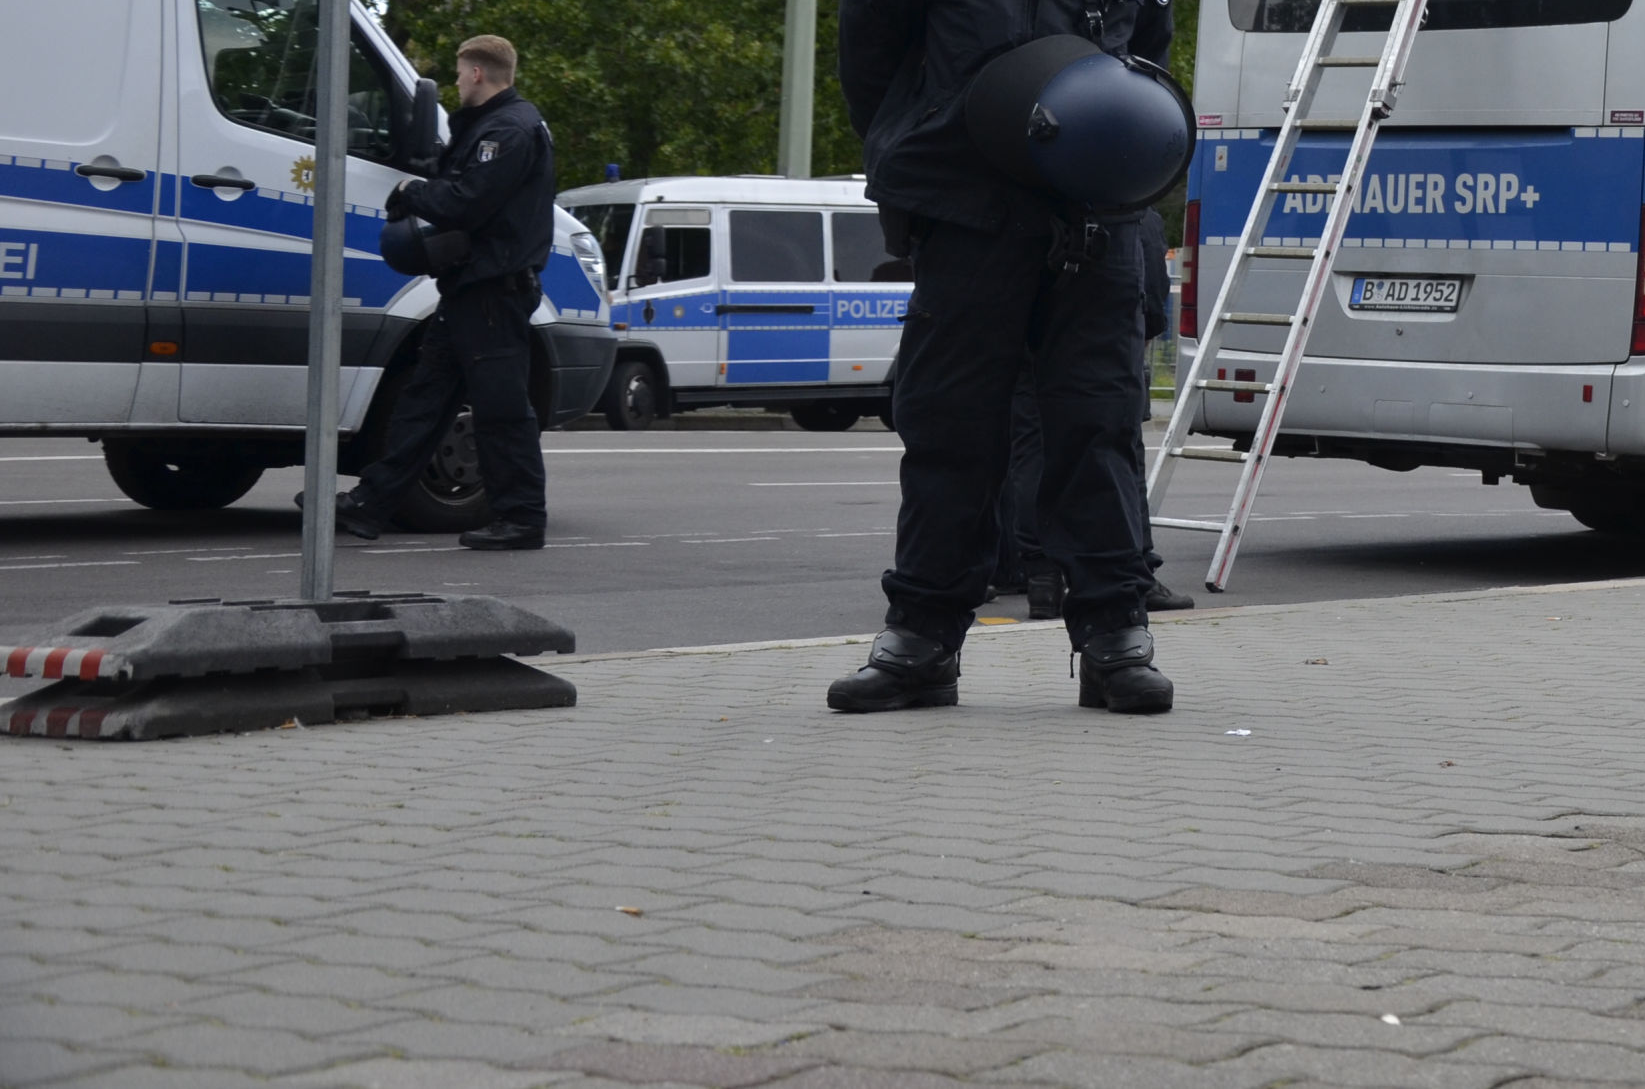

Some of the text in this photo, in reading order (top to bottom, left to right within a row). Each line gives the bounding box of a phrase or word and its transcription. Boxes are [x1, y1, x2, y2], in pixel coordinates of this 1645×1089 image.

[1454, 172, 1540, 214] SRP+
[1362, 281, 1457, 302] B AD 1952
